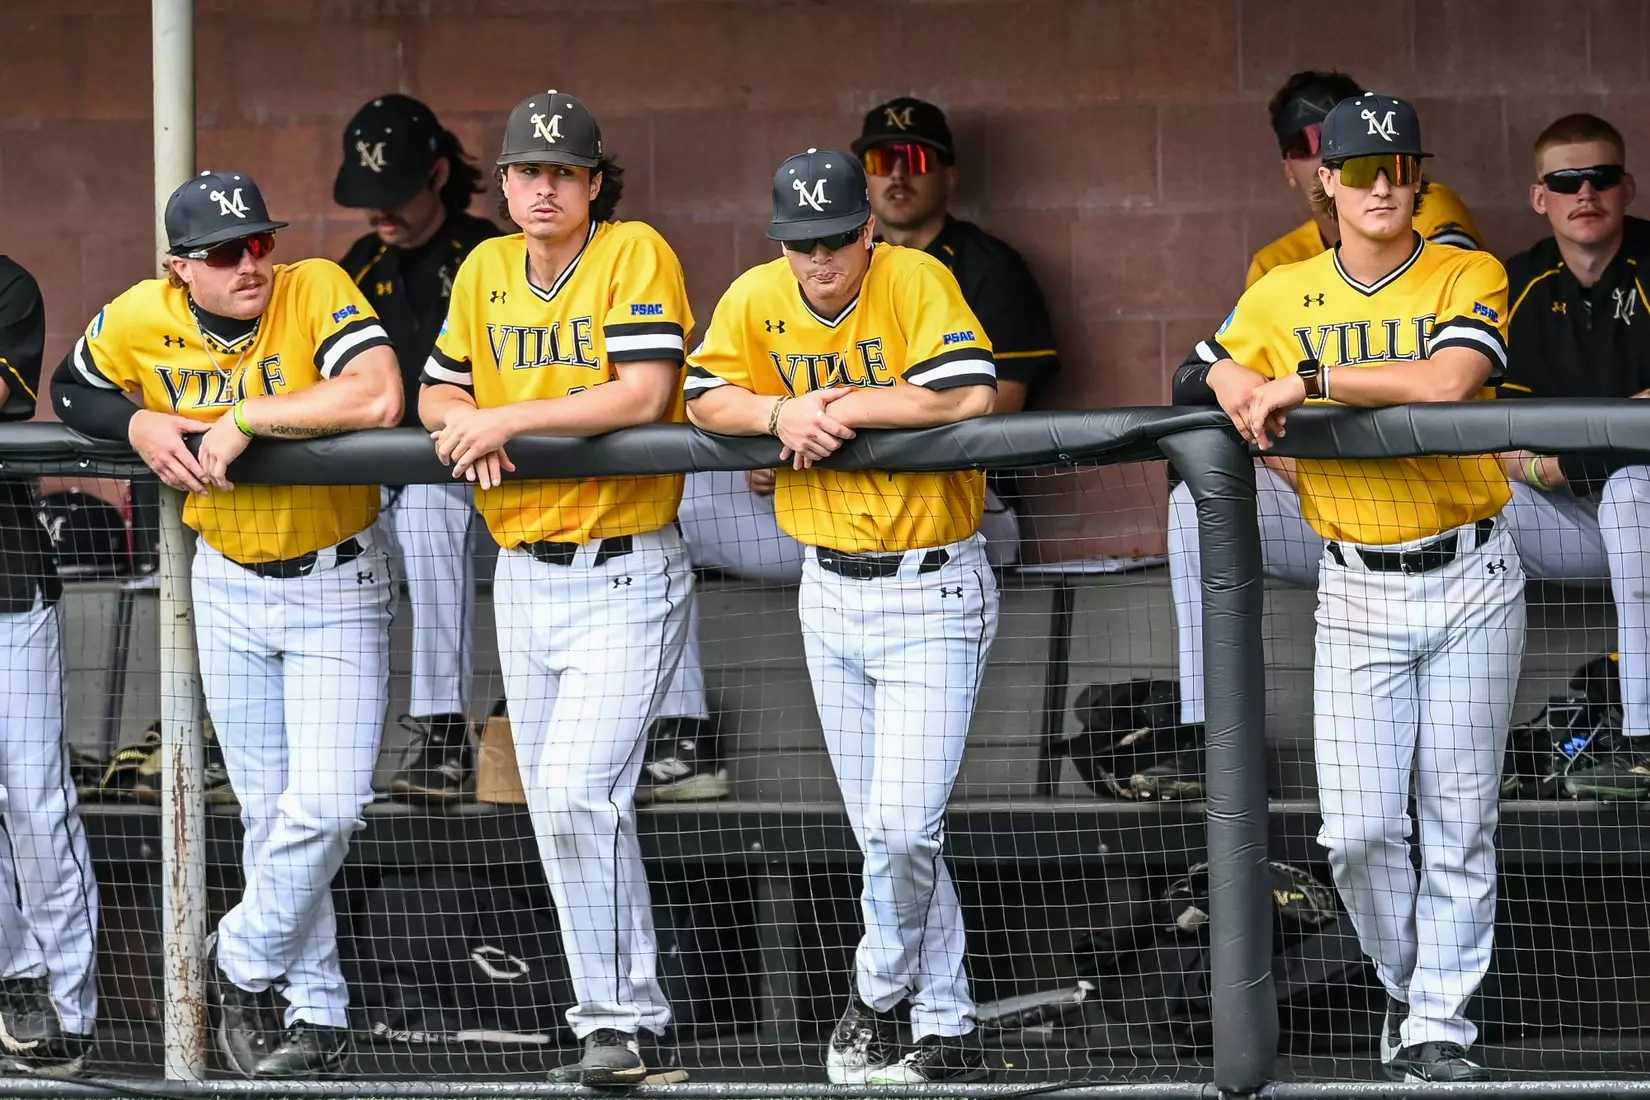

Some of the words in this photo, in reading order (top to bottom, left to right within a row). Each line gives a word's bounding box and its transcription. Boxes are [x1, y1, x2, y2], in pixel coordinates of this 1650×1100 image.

[531, 113, 563, 143] M
[1361, 109, 1398, 141] M
[209, 188, 250, 218] M
[793, 178, 830, 212] M
[631, 303, 663, 315] PSAC
[486, 316, 600, 375] VILLE
[943, 330, 976, 346] PSAC
[769, 337, 896, 398] VILLE
